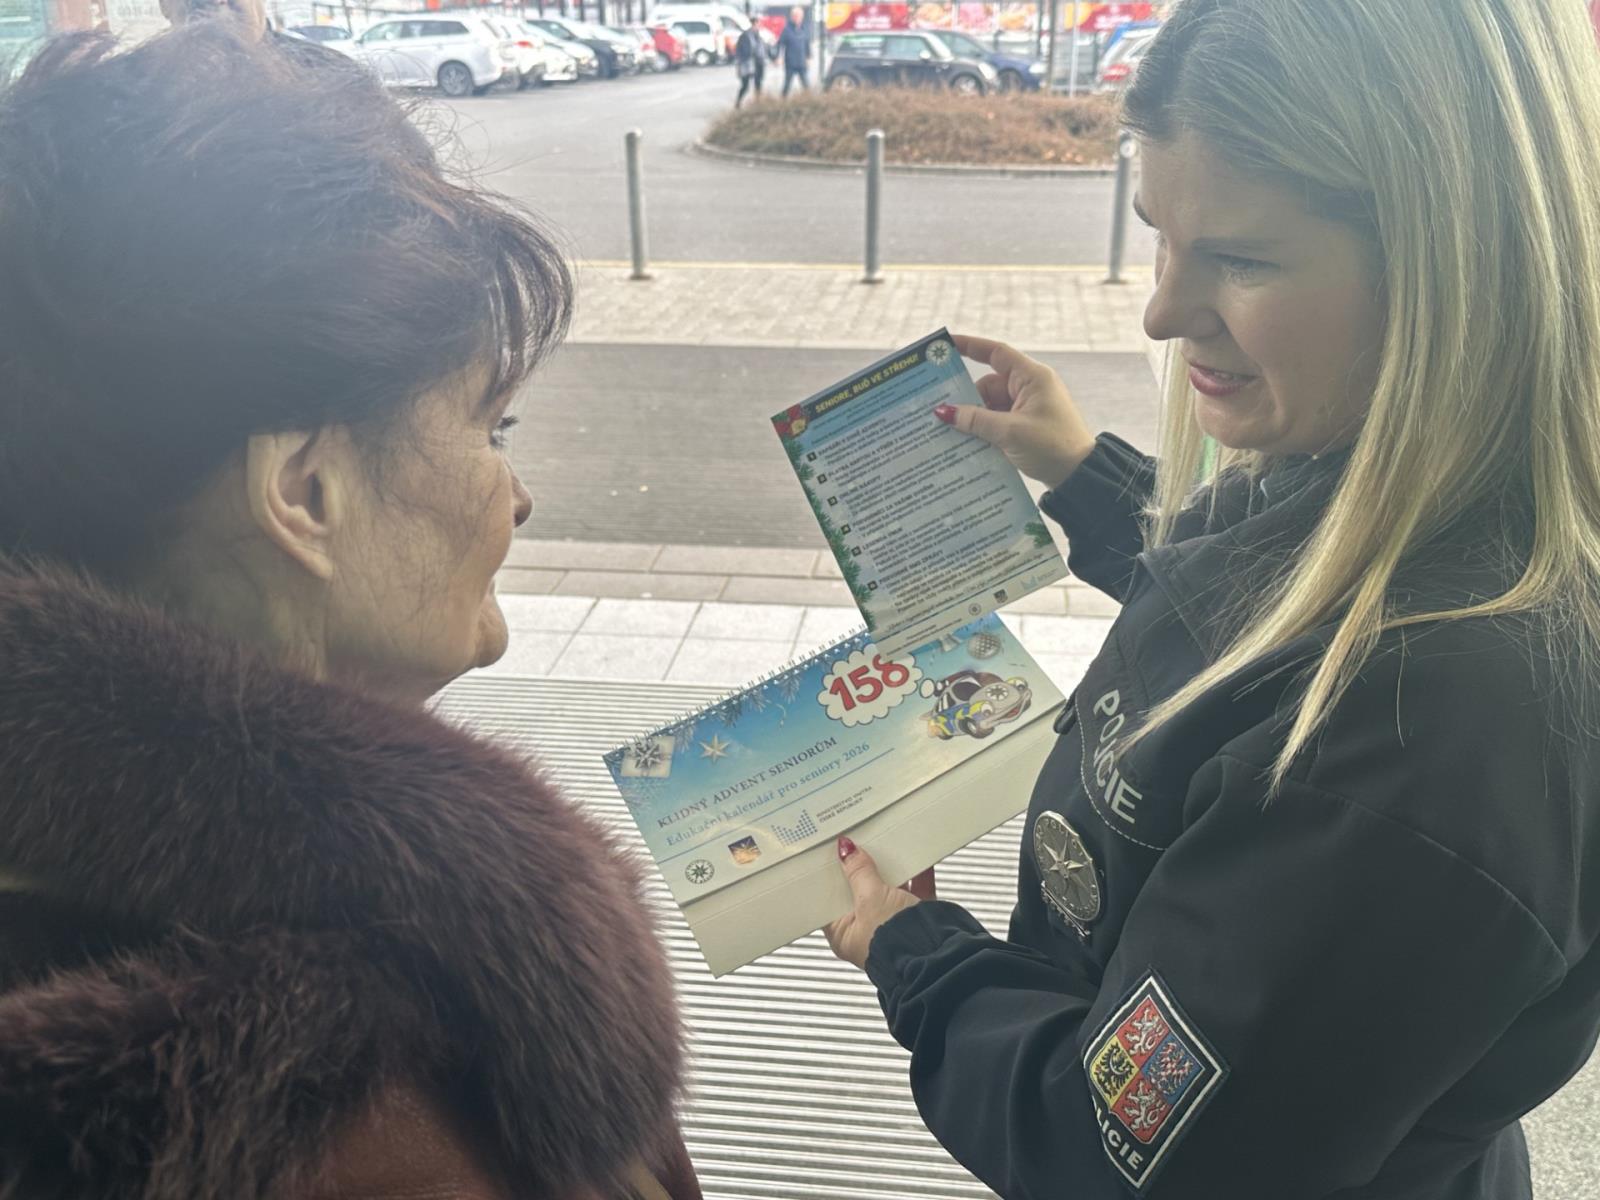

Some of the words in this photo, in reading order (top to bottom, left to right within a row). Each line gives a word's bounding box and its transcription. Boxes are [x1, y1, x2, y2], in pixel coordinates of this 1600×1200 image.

[815, 389, 852, 413] SENIORE,
[870, 372, 883, 385] VE
[829, 654, 910, 711] 158
[657, 799, 708, 828] KLIDNÝ
[713, 771, 767, 804] ADVENT
[769, 736, 838, 777] SENIORŮM
[666, 815, 721, 846] Edukační
[723, 791, 775, 822] kalendář
[778, 781, 798, 799] pro
[800, 759, 841, 784] seniory
[843, 742, 871, 762] 2026
[1096, 1107, 1143, 1170] LICIE
